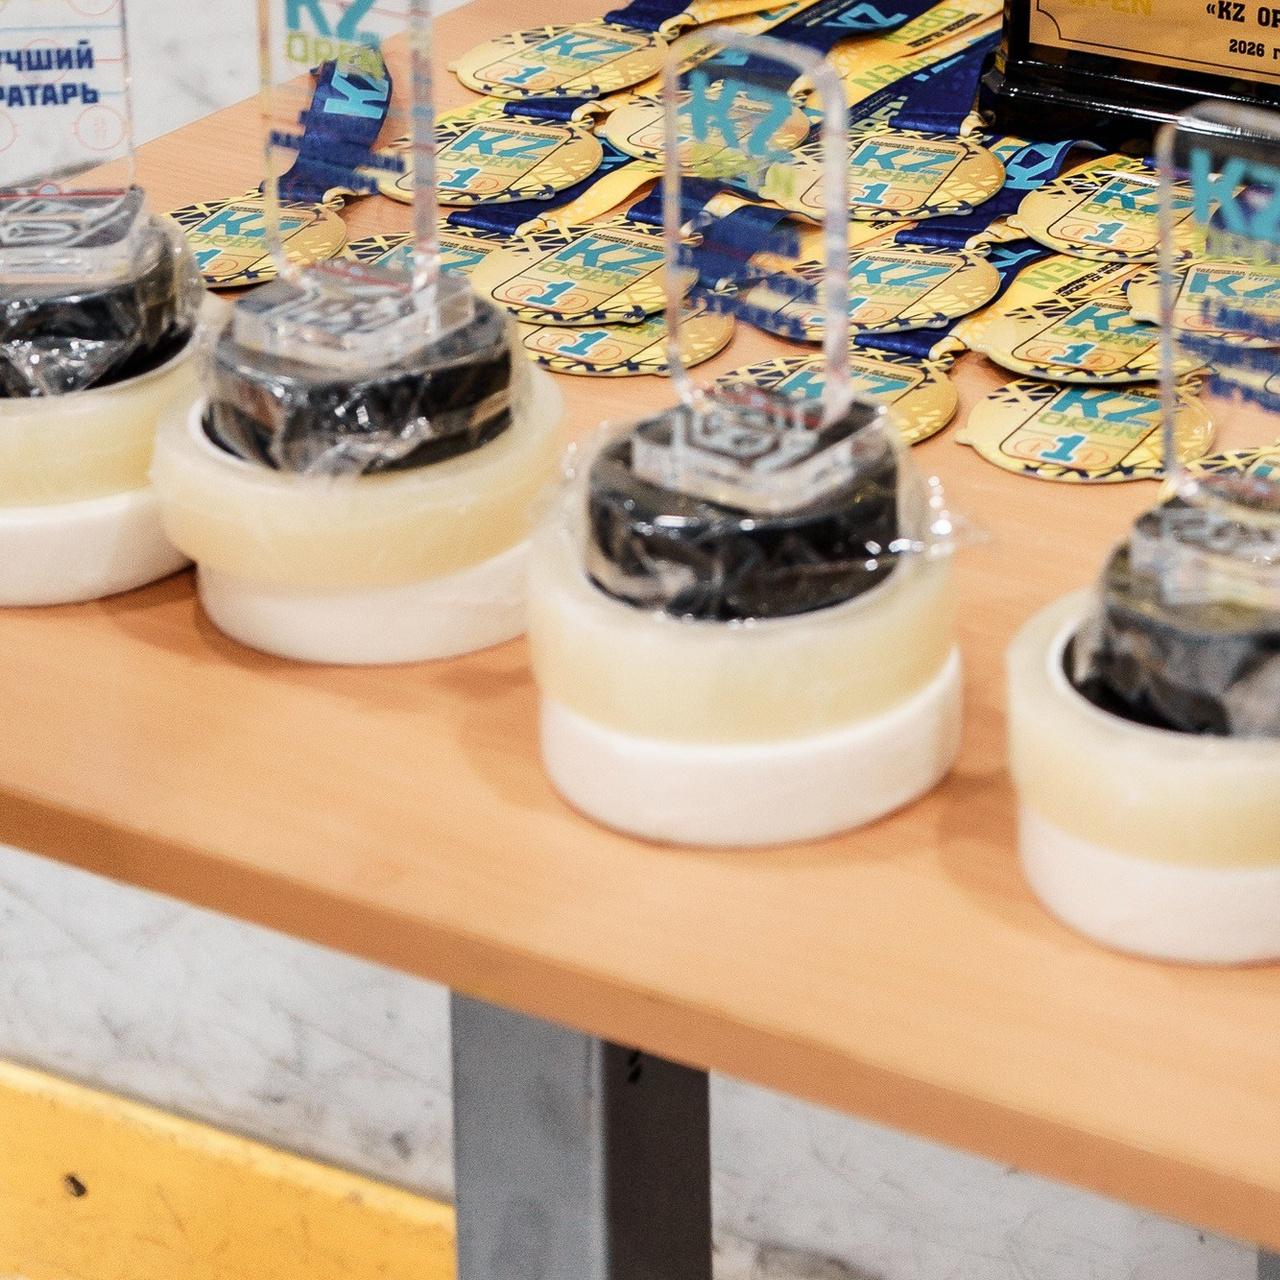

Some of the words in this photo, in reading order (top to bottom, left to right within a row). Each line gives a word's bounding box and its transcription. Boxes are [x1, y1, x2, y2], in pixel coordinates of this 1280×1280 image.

[1206, 0, 1246, 23] «KZ
[536, 34, 634, 62] KZ
[1229, 38, 1265, 58] 2026
[501, 65, 548, 84] 1
[451, 130, 560, 161] KZ
[851, 145, 957, 177] KZ
[438, 167, 482, 190] 1
[851, 182, 890, 205] 1
[1083, 221, 1125, 244] 1
[555, 237, 668, 277] KZ
[525, 280, 577, 307] 1
[557, 330, 610, 357] 1
[1050, 342, 1098, 365] 1
[1051, 386, 1164, 427] KZ
[1040, 434, 1089, 463] 1
